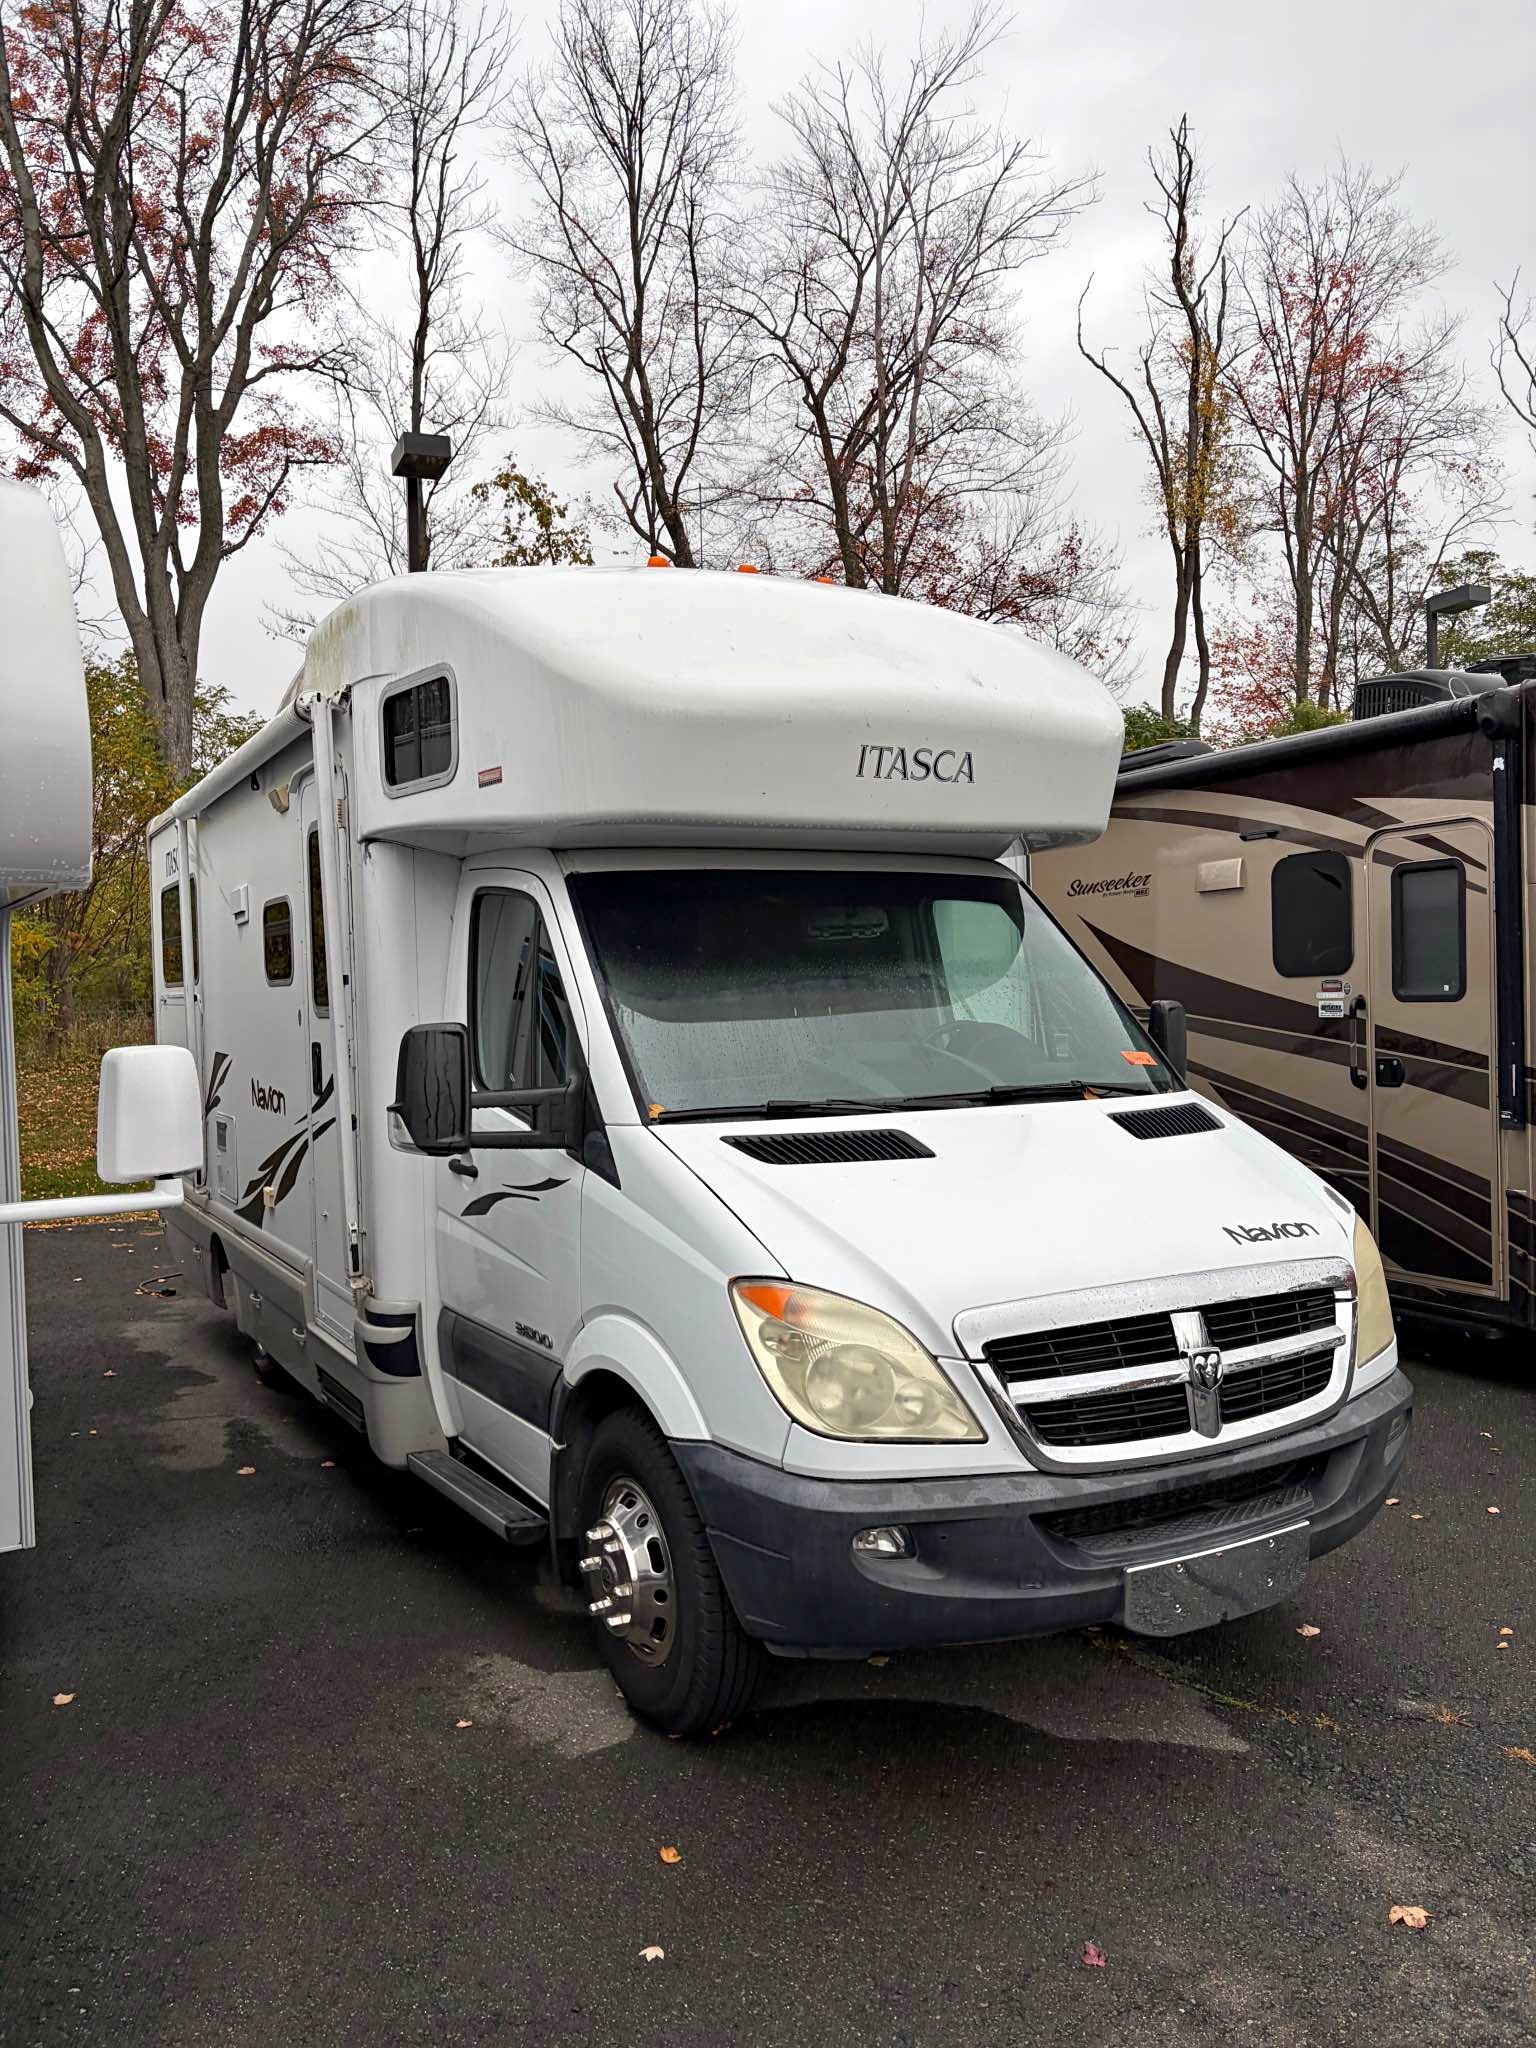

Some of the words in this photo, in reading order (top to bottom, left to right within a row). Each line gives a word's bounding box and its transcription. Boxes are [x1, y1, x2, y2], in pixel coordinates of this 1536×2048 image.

[856, 744, 975, 784] ITASCA
[1067, 871, 1152, 897] Sunseeker
[251, 1077, 286, 1116] Navion
[1222, 1222, 1320, 1246] Navion
